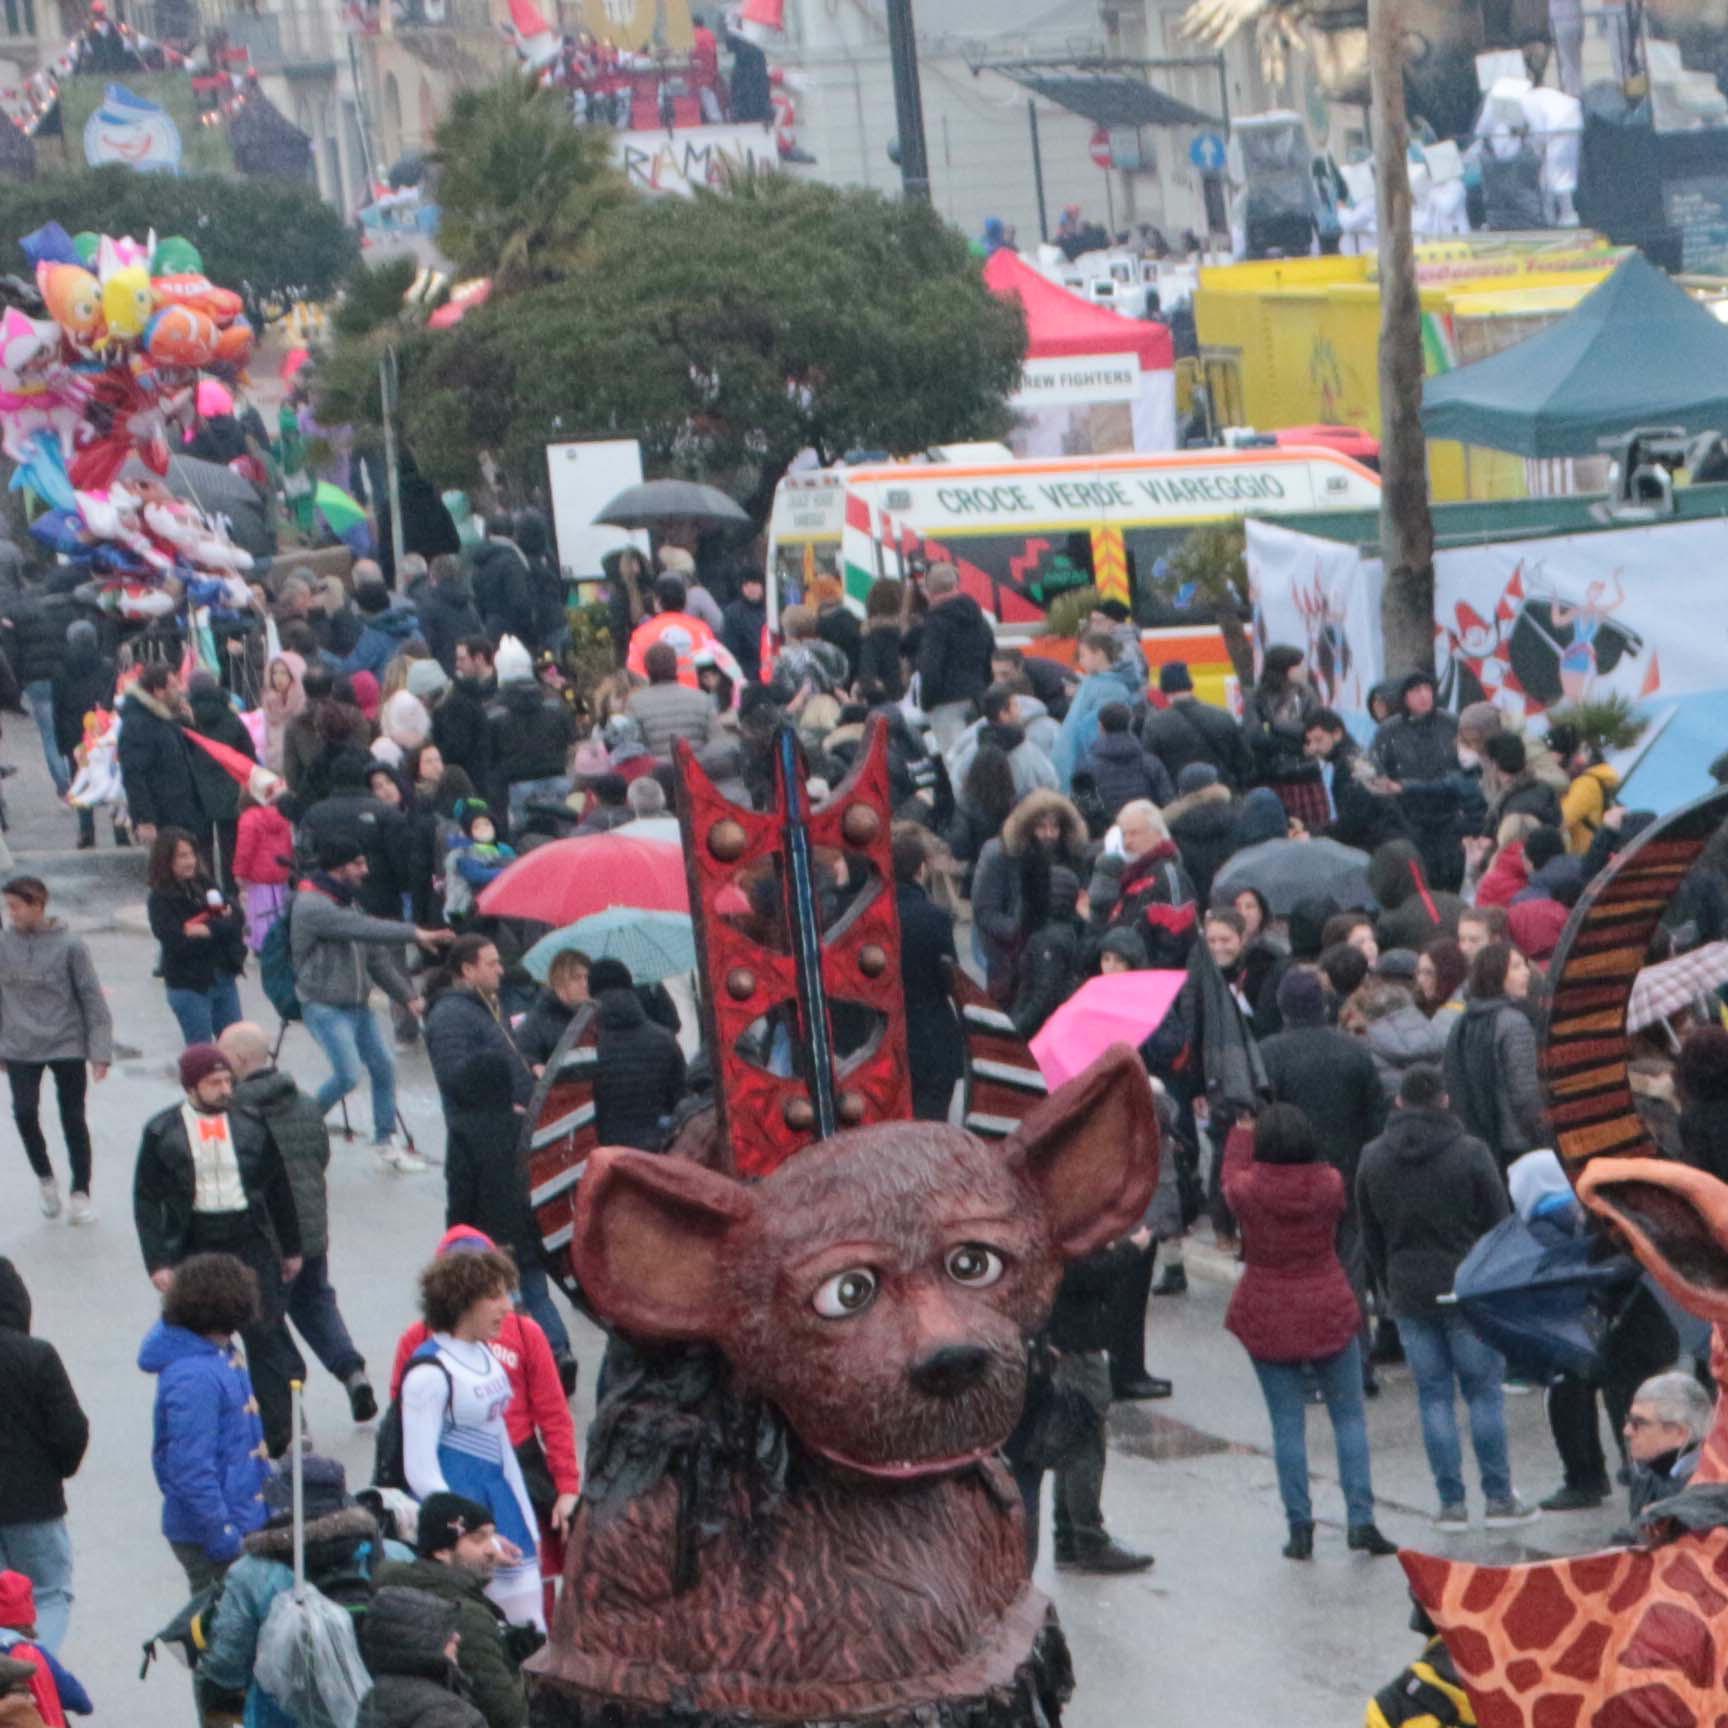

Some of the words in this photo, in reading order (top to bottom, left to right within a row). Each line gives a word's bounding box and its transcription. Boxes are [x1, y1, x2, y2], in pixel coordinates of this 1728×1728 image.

[1060, 369, 1133, 386] FIGHTERS
[937, 485, 1034, 514] CROCE
[1039, 481, 1136, 508] VERDE
[1137, 472, 1285, 502] VIAREGGIO
